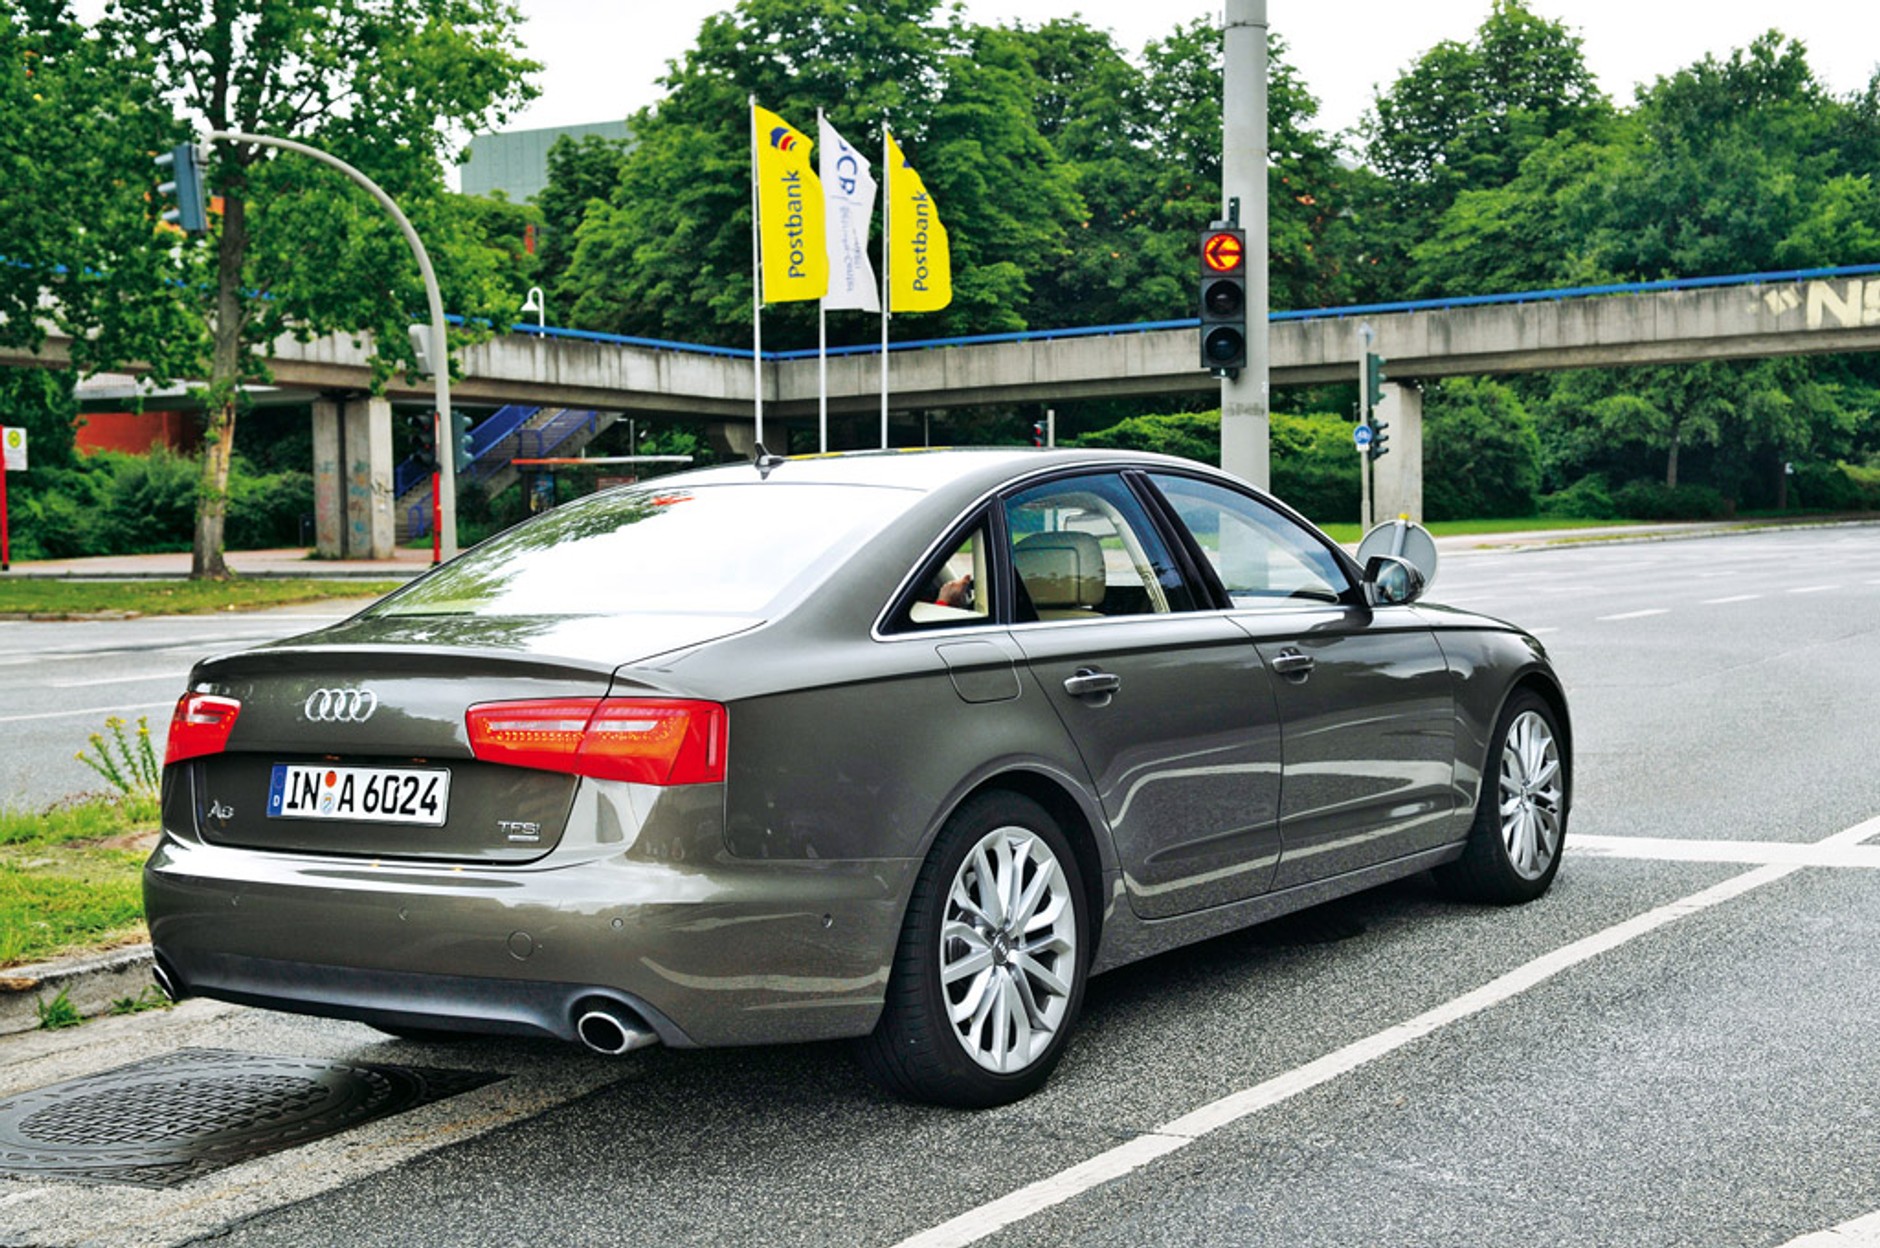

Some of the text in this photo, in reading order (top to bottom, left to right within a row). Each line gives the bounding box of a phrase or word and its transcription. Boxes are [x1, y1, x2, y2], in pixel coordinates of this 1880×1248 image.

[781, 170, 806, 278] Postbank
[911, 190, 929, 291] Postbank
[207, 800, 234, 819] A6
[272, 794, 281, 807] D
[287, 771, 439, 816] IN A 6024
